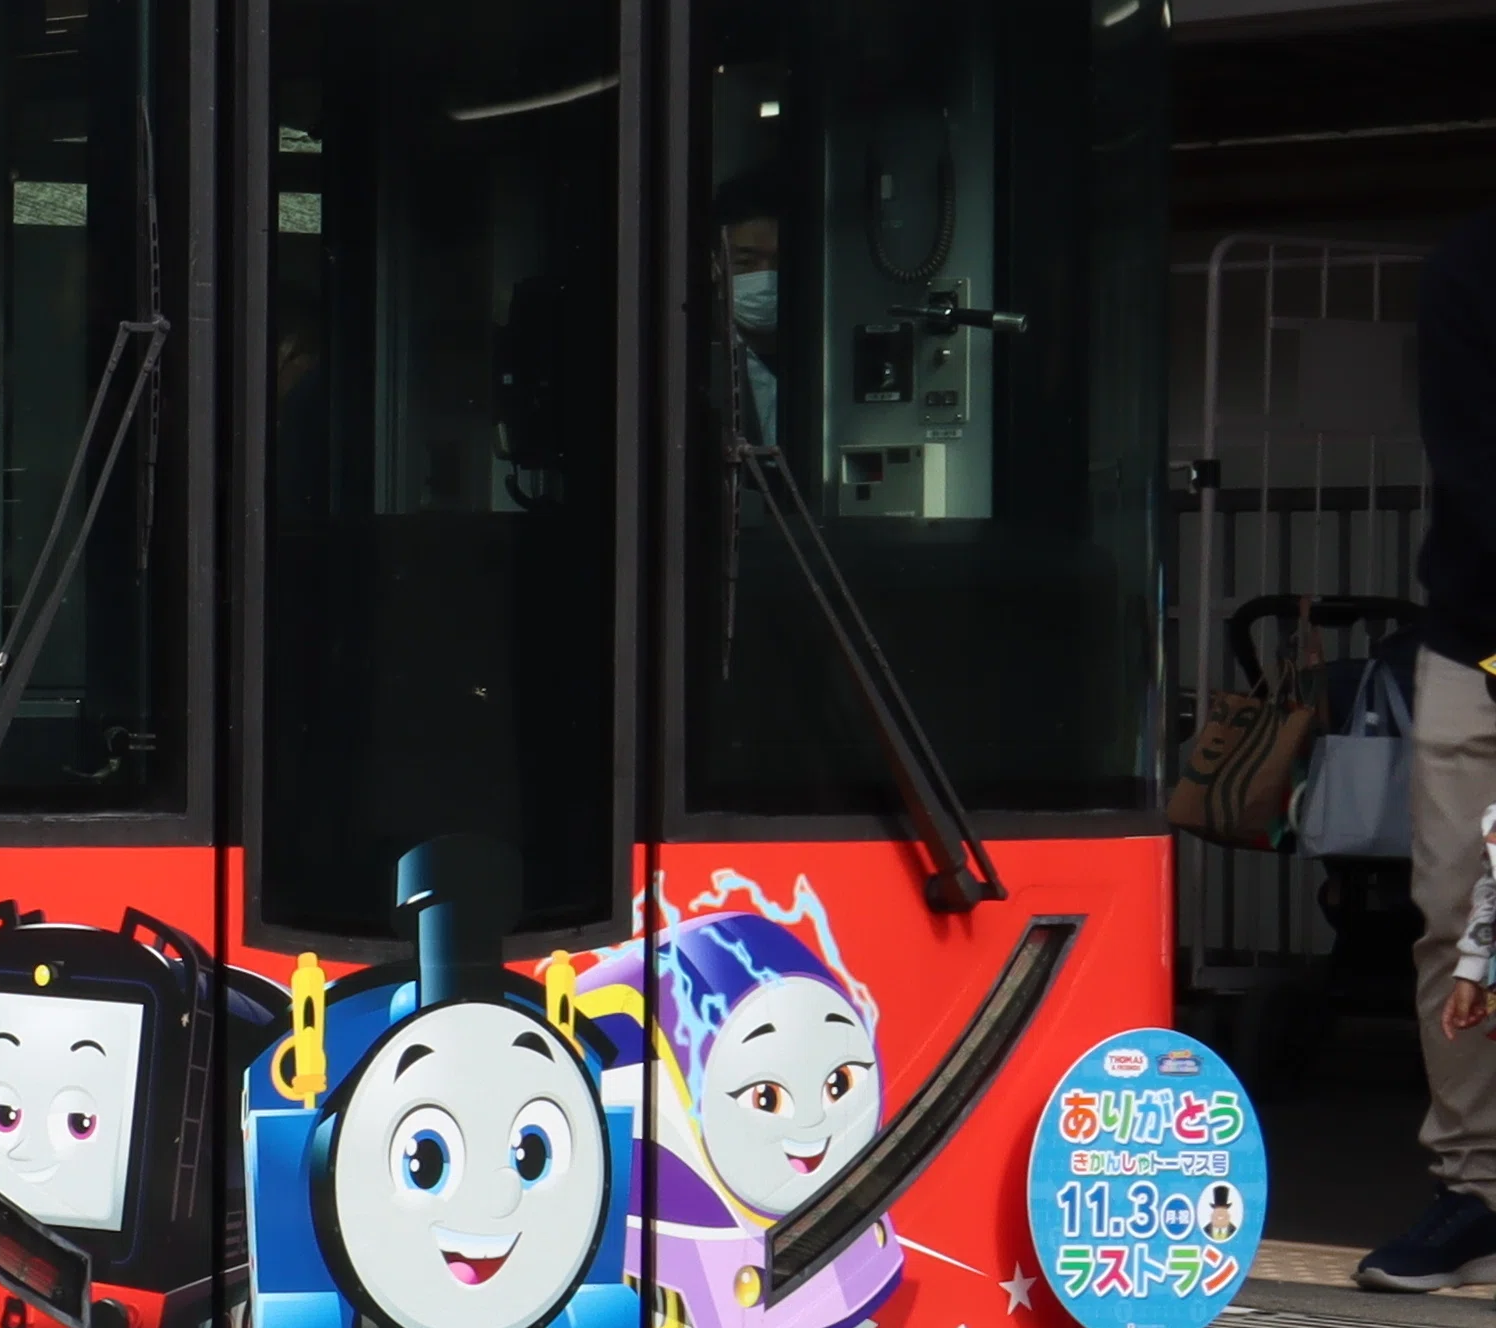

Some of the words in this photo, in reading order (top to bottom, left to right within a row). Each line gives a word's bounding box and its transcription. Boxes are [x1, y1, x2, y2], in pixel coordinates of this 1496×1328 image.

[1059, 1088, 1243, 1145] ありがとう
[1072, 1150, 1229, 1175] きかんしゃトーマス号
[1057, 1180, 1159, 1238] 11.3
[1057, 1243, 1239, 1297] ラストラン
